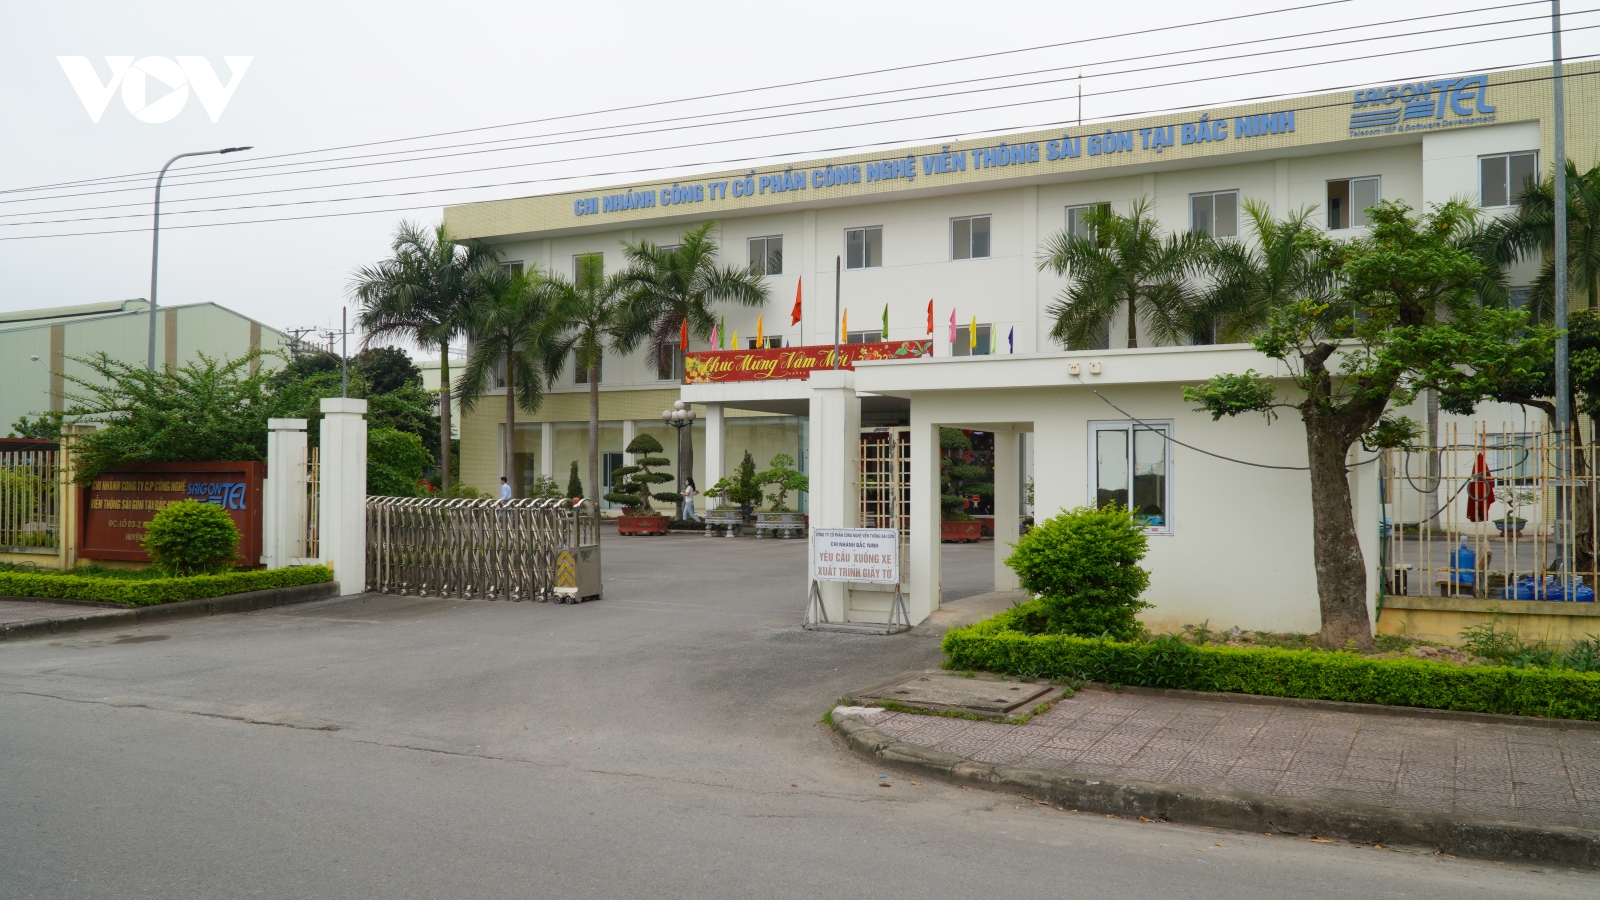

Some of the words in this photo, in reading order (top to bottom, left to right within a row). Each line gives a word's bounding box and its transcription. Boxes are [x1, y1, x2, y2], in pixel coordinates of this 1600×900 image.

[1405, 121, 1440, 131] Software
[1441, 115, 1497, 127] Development
[574, 197, 599, 216] CHI
[602, 188, 656, 213] NHÁNH
[660, 182, 704, 207] CÔNG
[708, 181, 728, 200] TY
[732, 169, 755, 198] CỔ
[759, 165, 807, 194] PHẦN
[811, 164, 861, 189] CÔNG
[866, 153, 917, 181] NGHỆ
[922, 145, 967, 175] VIỄN
[972, 142, 1040, 169] THÔNG
[1046, 133, 1081, 161] SÀI
[1087, 129, 1134, 156] GÒN
[1139, 125, 1175, 153] TẠI
[1181, 113, 1228, 145] BẮC
[1235, 110, 1296, 139] NINH
[704, 356, 735, 379] Chúc
[735, 355, 778, 378] Mừng
[92, 481, 101, 491] CHI
[102, 478, 120, 491] NHÁNH
[137, 481, 144, 491] TY
[155, 479, 170, 491] CÔNG
[171, 479, 186, 494] NGHỆ
[90, 494, 103, 509] VIỄN
[104, 497, 121, 510] THÔNG
[121, 497, 131, 510] SÀI
[132, 497, 145, 510] GÒN
[145, 500, 154, 513] TẠI
[819, 550, 834, 562] YÊU
[836, 549, 850, 563] CẦU
[853, 549, 879, 564] XUỐNG
[881, 554, 892, 564] XE
[817, 563, 837, 576] XUẤT
[839, 565, 860, 577] TRÌNH
[863, 565, 880, 578] GIẤY
[882, 566, 892, 579] TỜ
